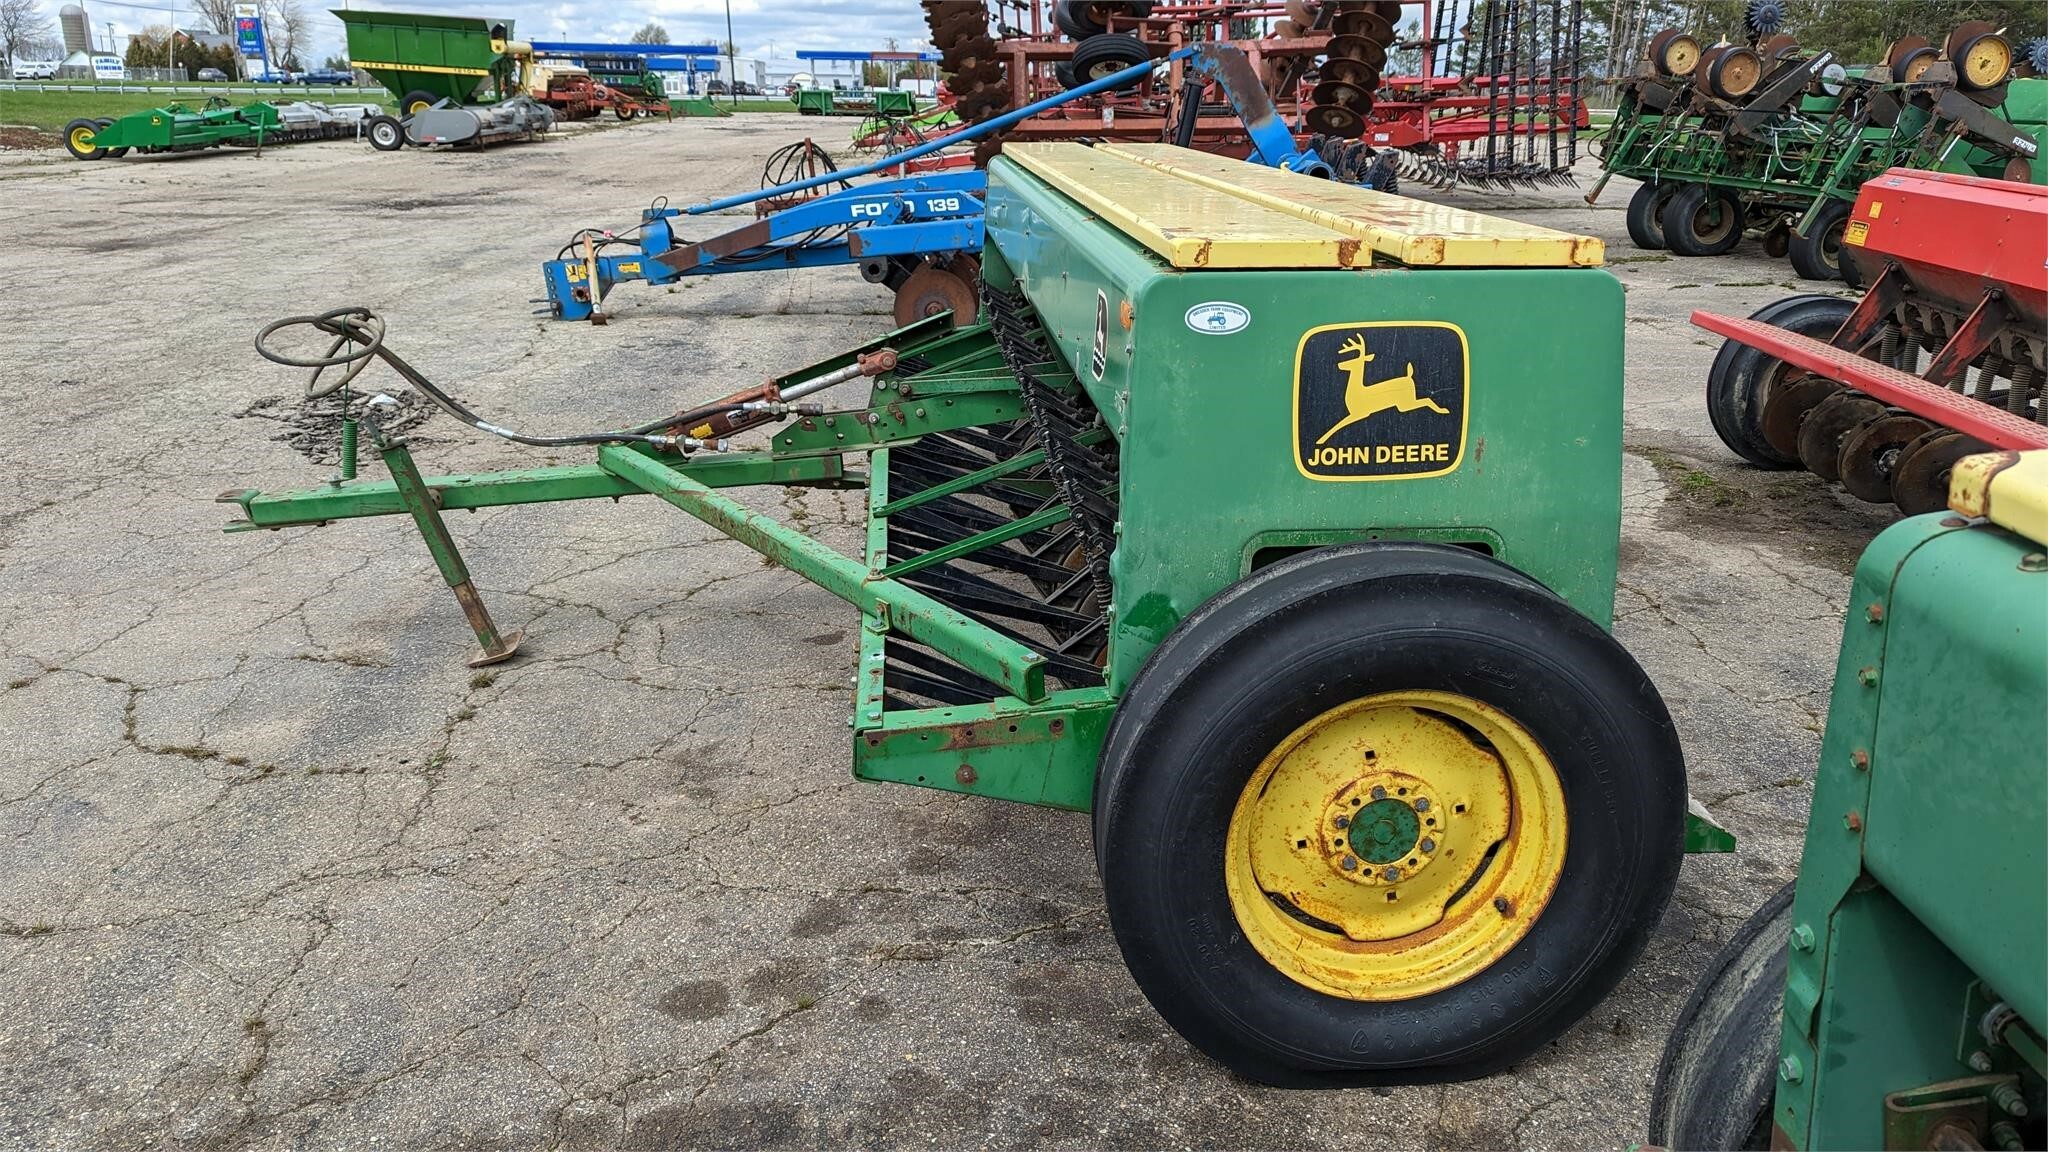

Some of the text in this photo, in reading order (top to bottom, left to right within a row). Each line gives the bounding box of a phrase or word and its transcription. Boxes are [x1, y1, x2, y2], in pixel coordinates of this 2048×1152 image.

[926, 198, 960, 213] 139
[1308, 443, 1449, 467] JOHN DEERE
